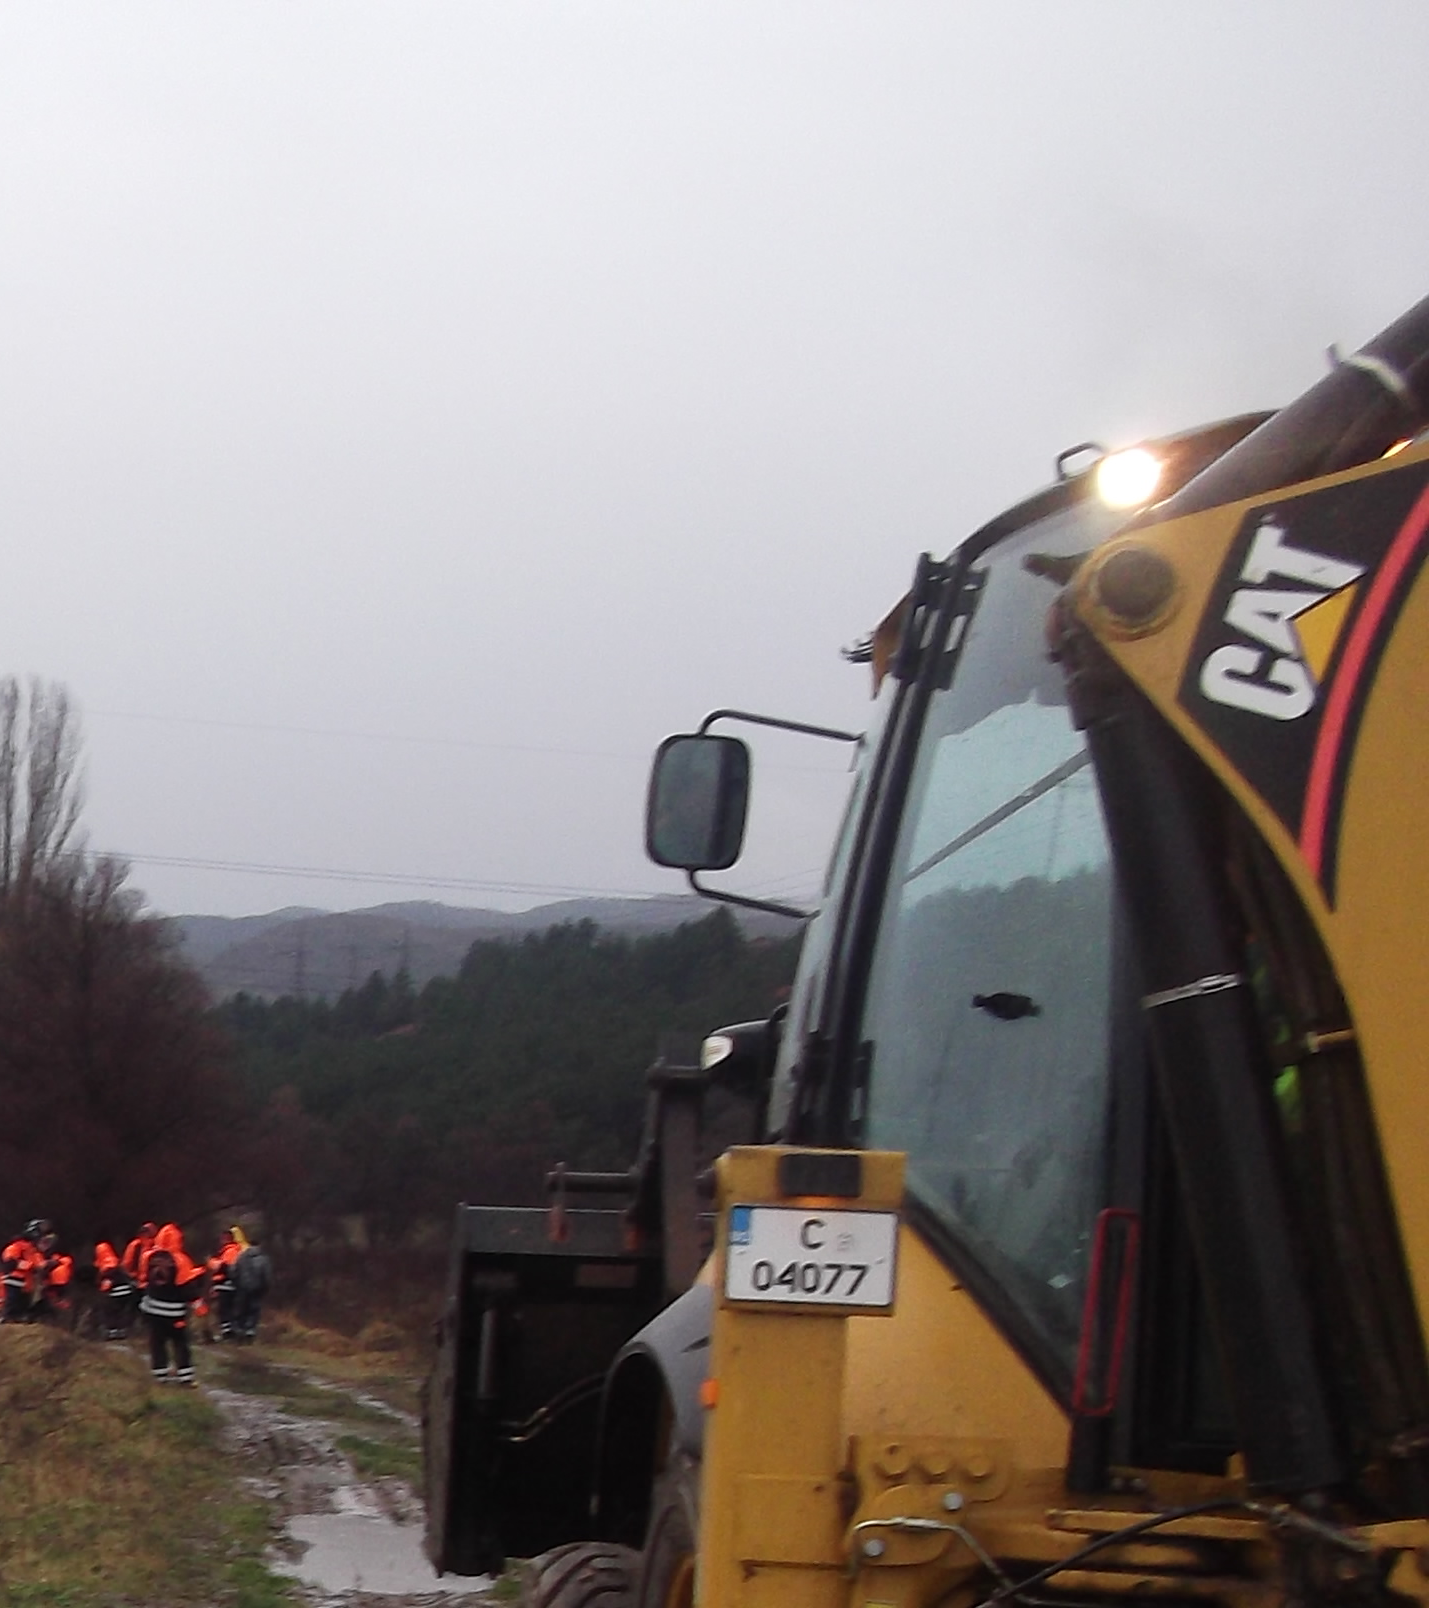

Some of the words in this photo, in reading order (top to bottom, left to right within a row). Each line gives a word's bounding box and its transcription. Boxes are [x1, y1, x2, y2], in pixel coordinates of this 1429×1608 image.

[1198, 524, 1367, 721] CAT
[799, 1218, 826, 1250] C
[752, 1259, 869, 1297] 04077
